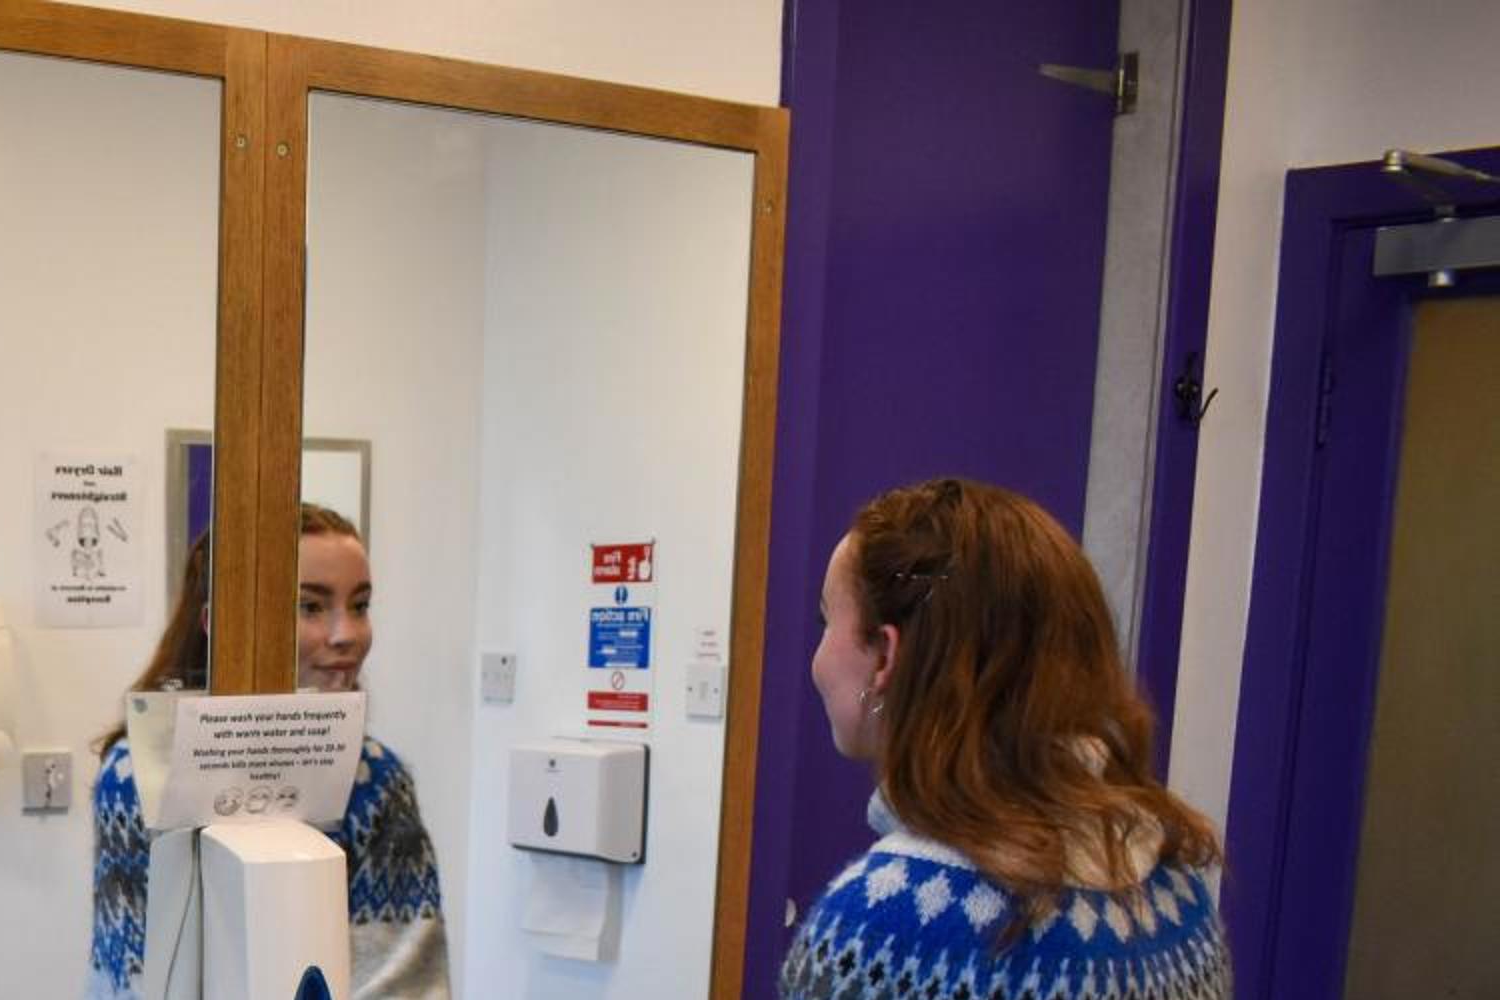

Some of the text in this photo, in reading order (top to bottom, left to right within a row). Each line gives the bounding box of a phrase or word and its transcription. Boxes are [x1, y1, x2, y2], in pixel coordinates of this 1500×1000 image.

[200, 709, 346, 724] Please wash your hands frequently
[213, 724, 331, 739] with warm water and soap!
[193, 748, 225, 758] Washing
[227, 749, 244, 757] your
[247, 746, 269, 755] hands
[272, 745, 311, 755] thoroughly
[313, 743, 324, 753] for
[200, 762, 230, 771] seconds
